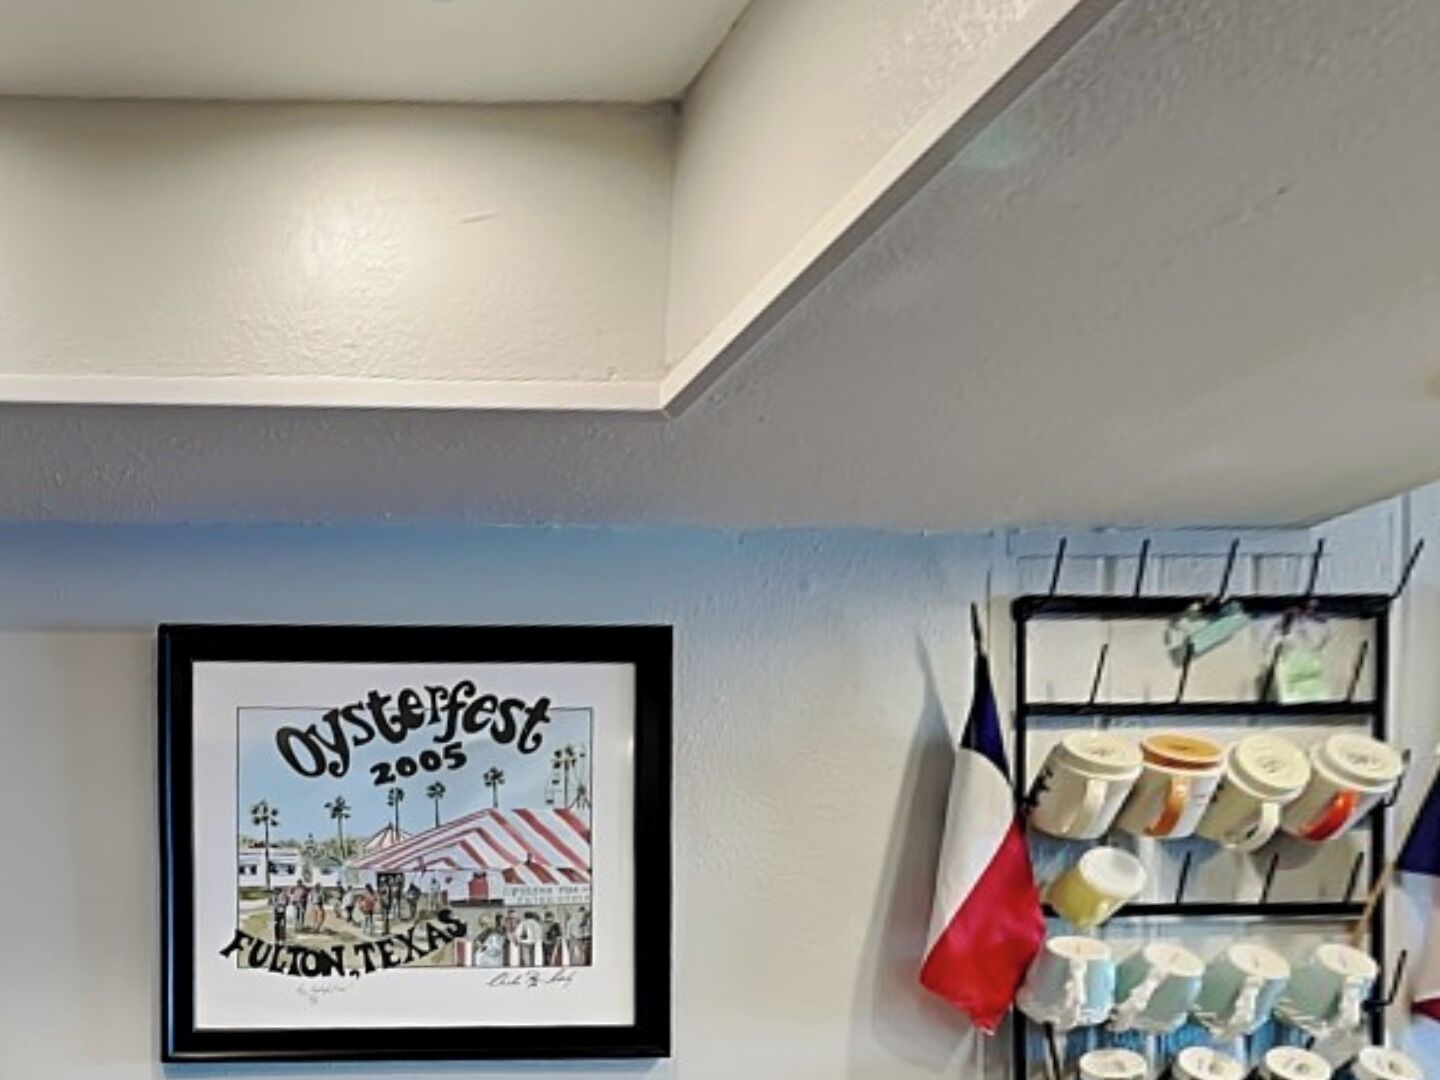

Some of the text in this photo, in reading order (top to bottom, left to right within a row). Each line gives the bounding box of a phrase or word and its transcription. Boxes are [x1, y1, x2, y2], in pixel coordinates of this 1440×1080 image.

[276, 681, 550, 778] Oysterfest
[370, 742, 468, 785] 2005
[354, 908, 467, 974] TEXAS
